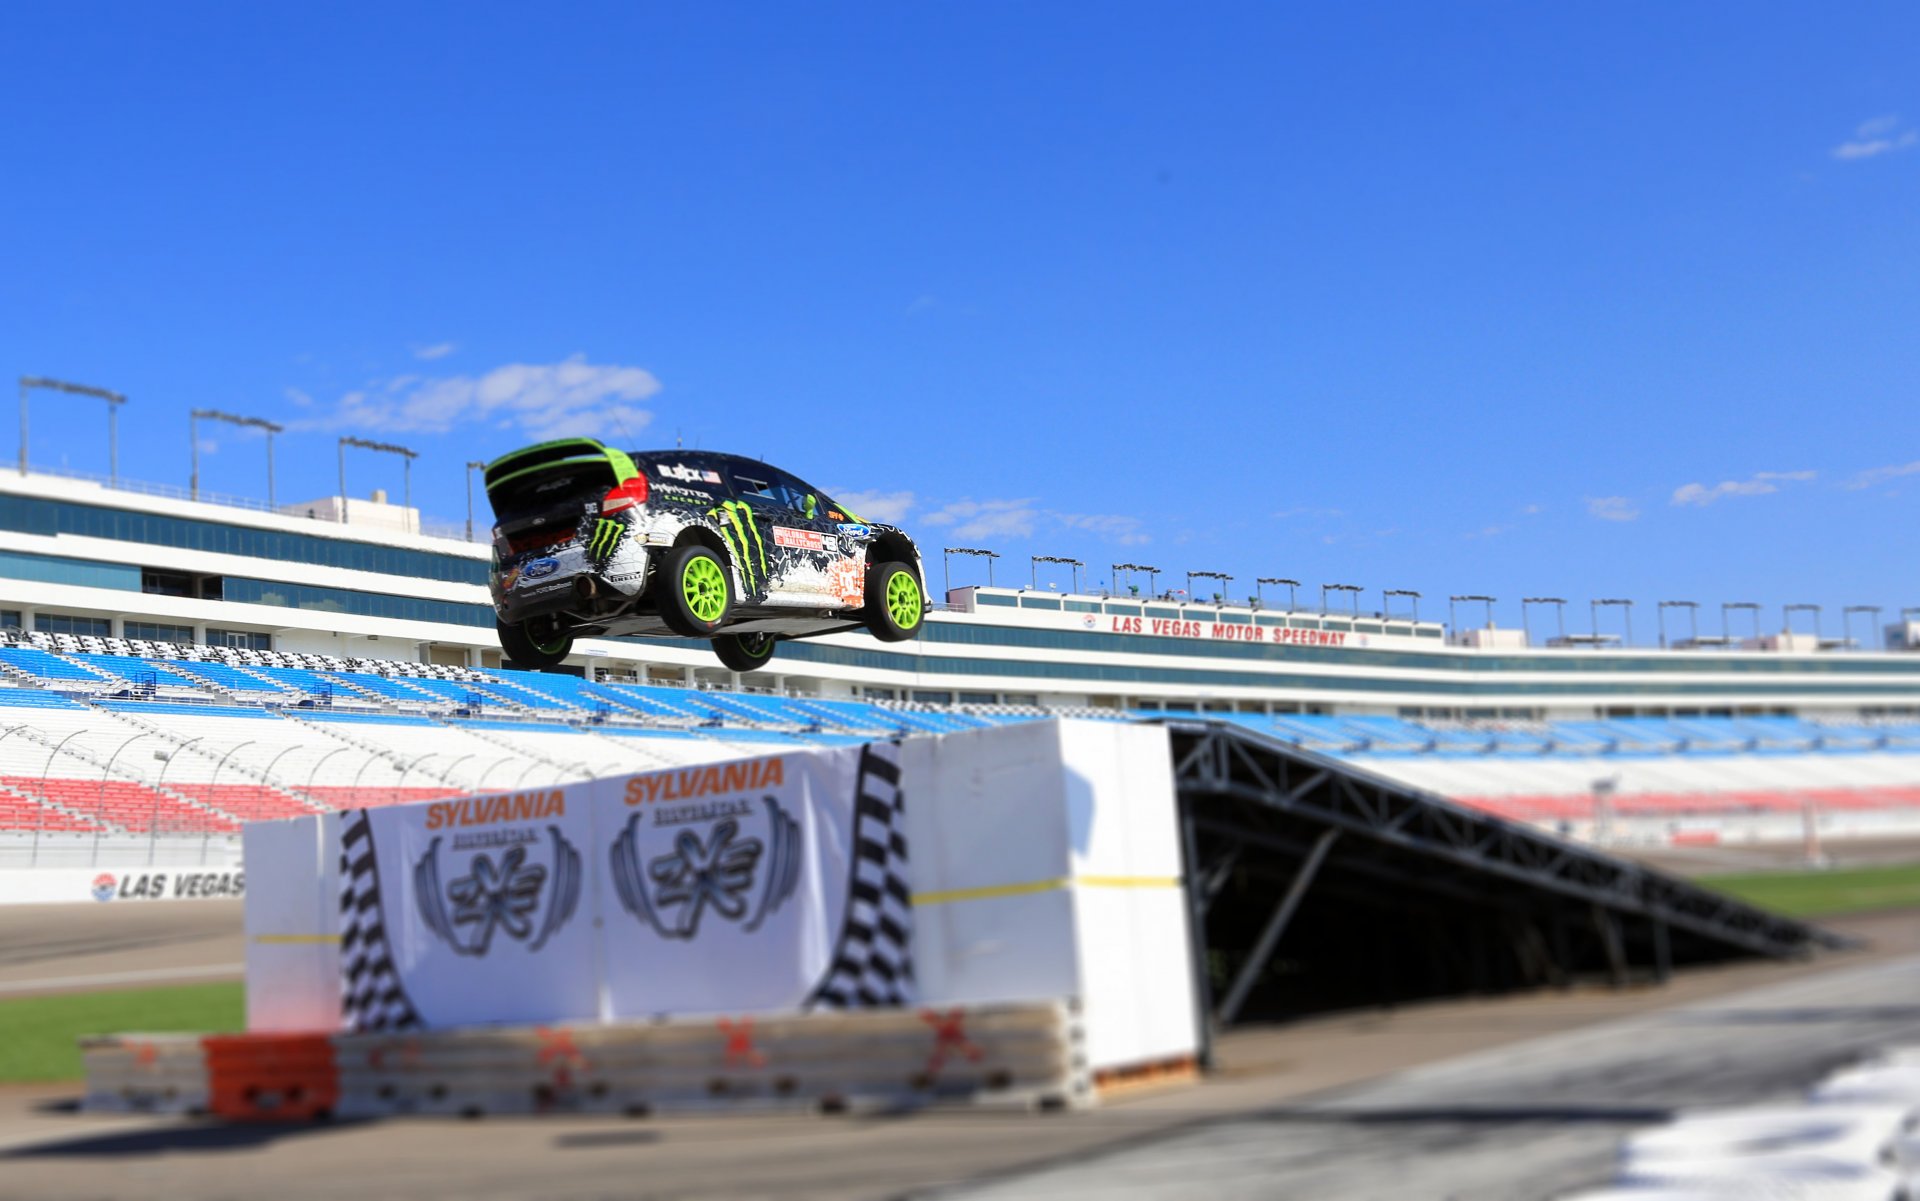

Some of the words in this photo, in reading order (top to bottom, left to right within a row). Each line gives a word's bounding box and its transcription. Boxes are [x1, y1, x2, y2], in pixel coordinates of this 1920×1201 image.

[664, 495, 707, 505] ENERGY
[843, 525, 865, 537] Ford
[529, 559, 555, 577] Ford
[610, 571, 641, 583] PIRELLI
[1112, 616, 1142, 633] LAS
[1152, 618, 1201, 637] VEGAS
[1211, 623, 1263, 641] MOTOR
[1273, 627, 1346, 646] SPEEDWAY
[624, 757, 784, 806] SYLVANIA
[425, 789, 565, 831] SYLVANIA
[118, 873, 167, 899] LAS
[173, 872, 246, 898] VEGAS
